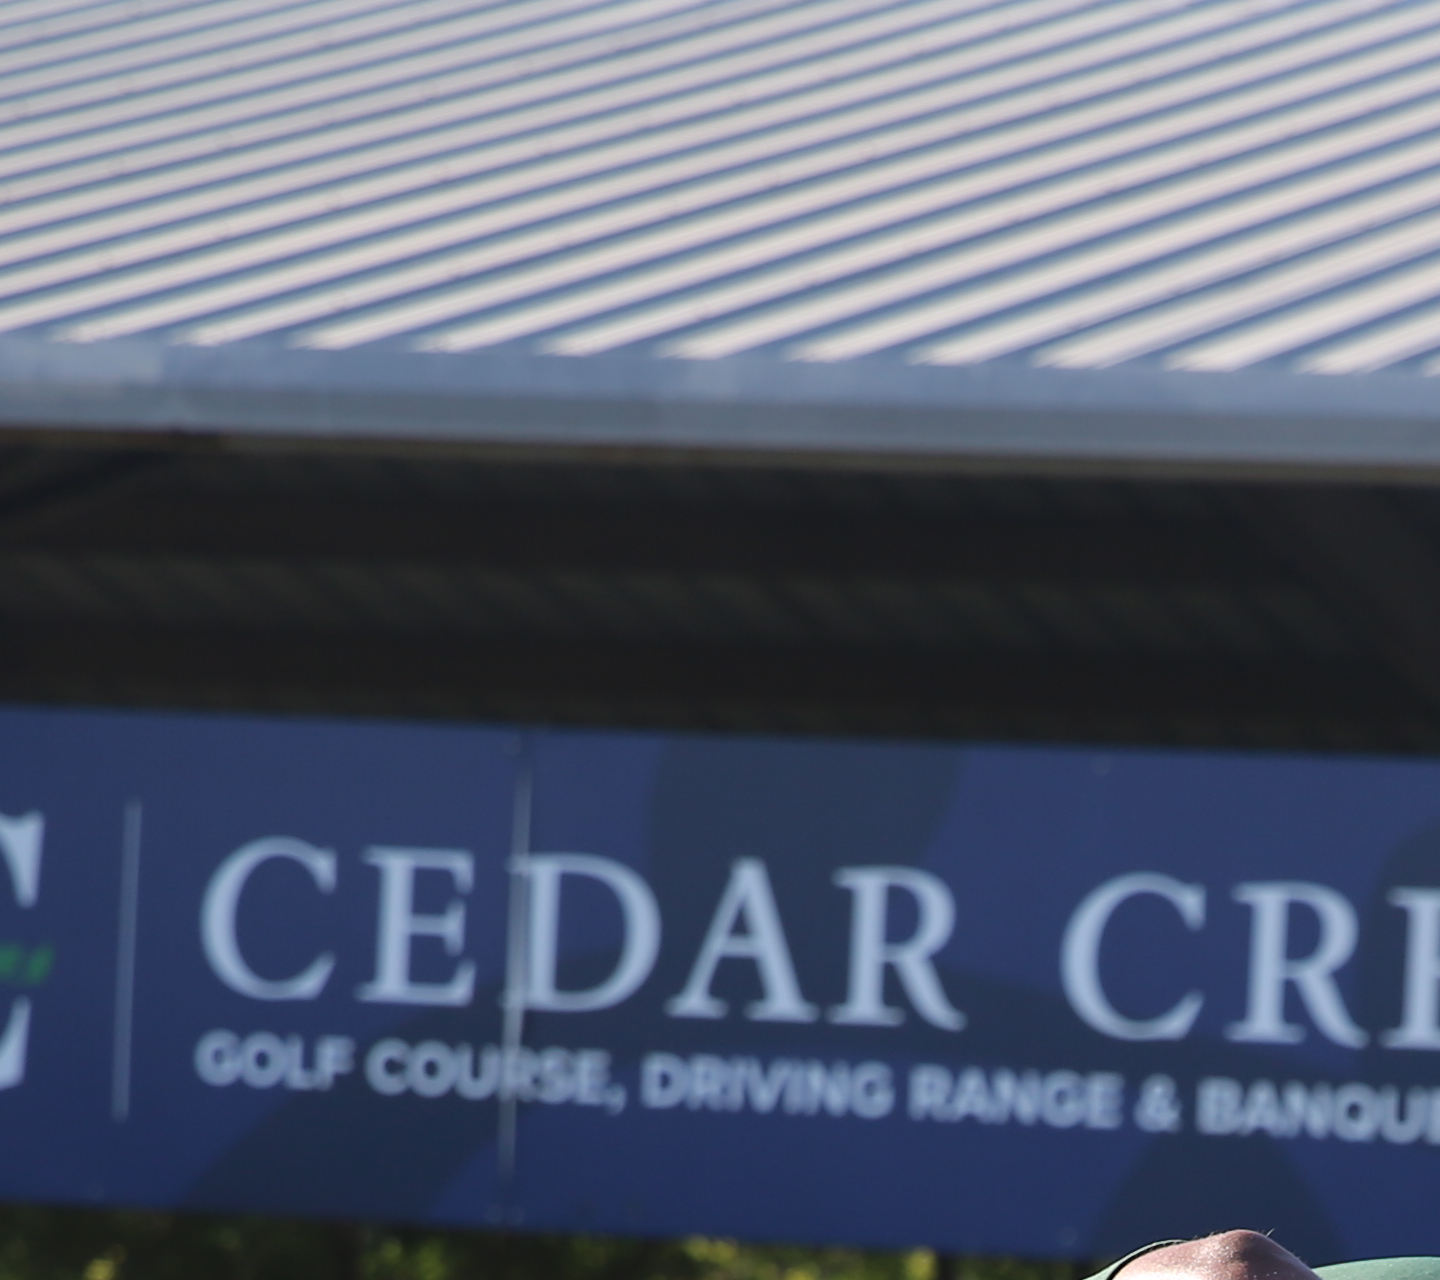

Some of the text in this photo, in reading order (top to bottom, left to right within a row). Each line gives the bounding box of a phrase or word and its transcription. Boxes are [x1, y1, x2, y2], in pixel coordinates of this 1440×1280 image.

[200, 836, 965, 1031] CEDAR
[194, 1030, 354, 1090] GOLF
[365, 1038, 627, 1115] COURSE,
[640, 1051, 896, 1118] DRIVING
[908, 1064, 1124, 1130] RANGE
[1134, 1074, 1182, 1132] &
